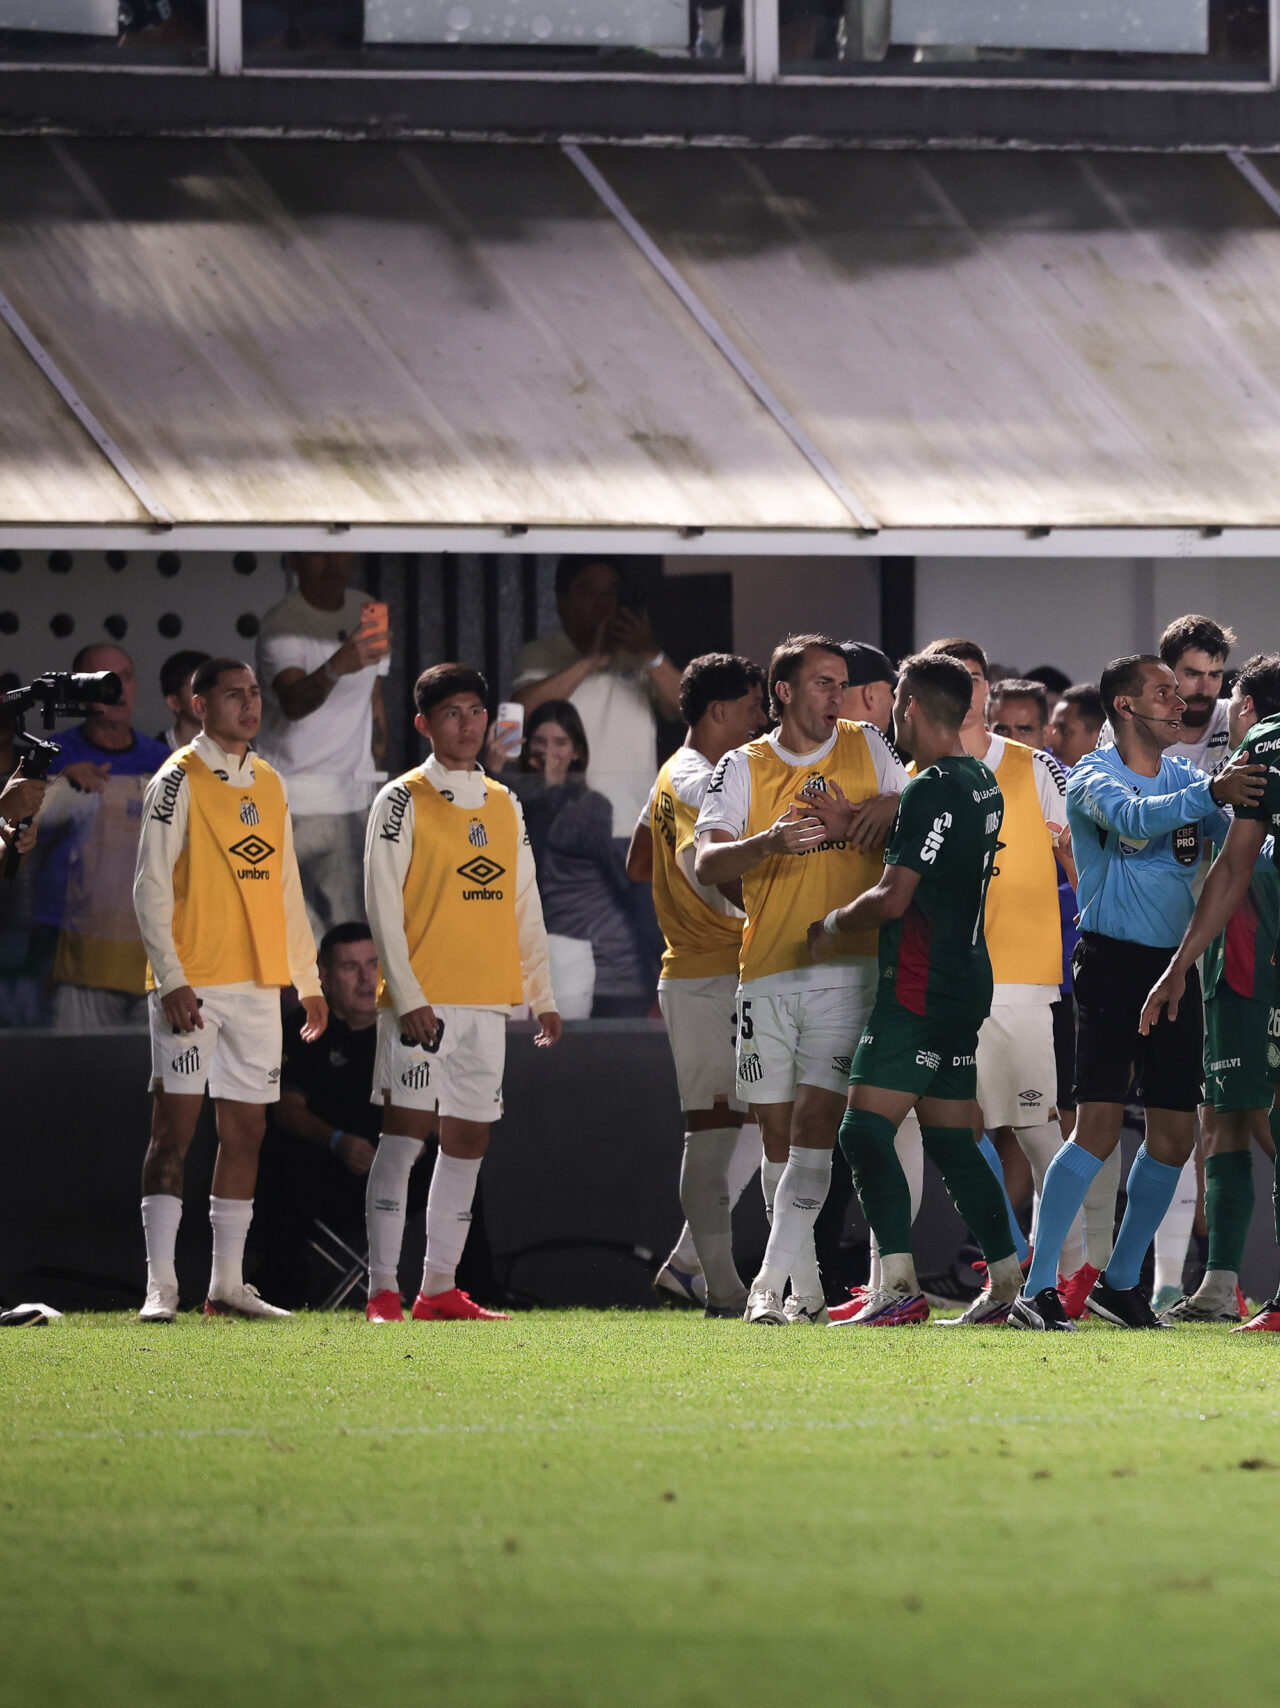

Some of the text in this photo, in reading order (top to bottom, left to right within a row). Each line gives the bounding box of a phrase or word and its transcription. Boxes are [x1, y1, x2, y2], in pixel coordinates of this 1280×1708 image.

[380, 785, 412, 843] Kicald
[1177, 828, 1194, 837] CBF
[1177, 838, 1195, 848] PRO
[237, 867, 270, 879] umbro
[463, 888, 503, 900] umbro
[741, 1001, 754, 1039] 5
